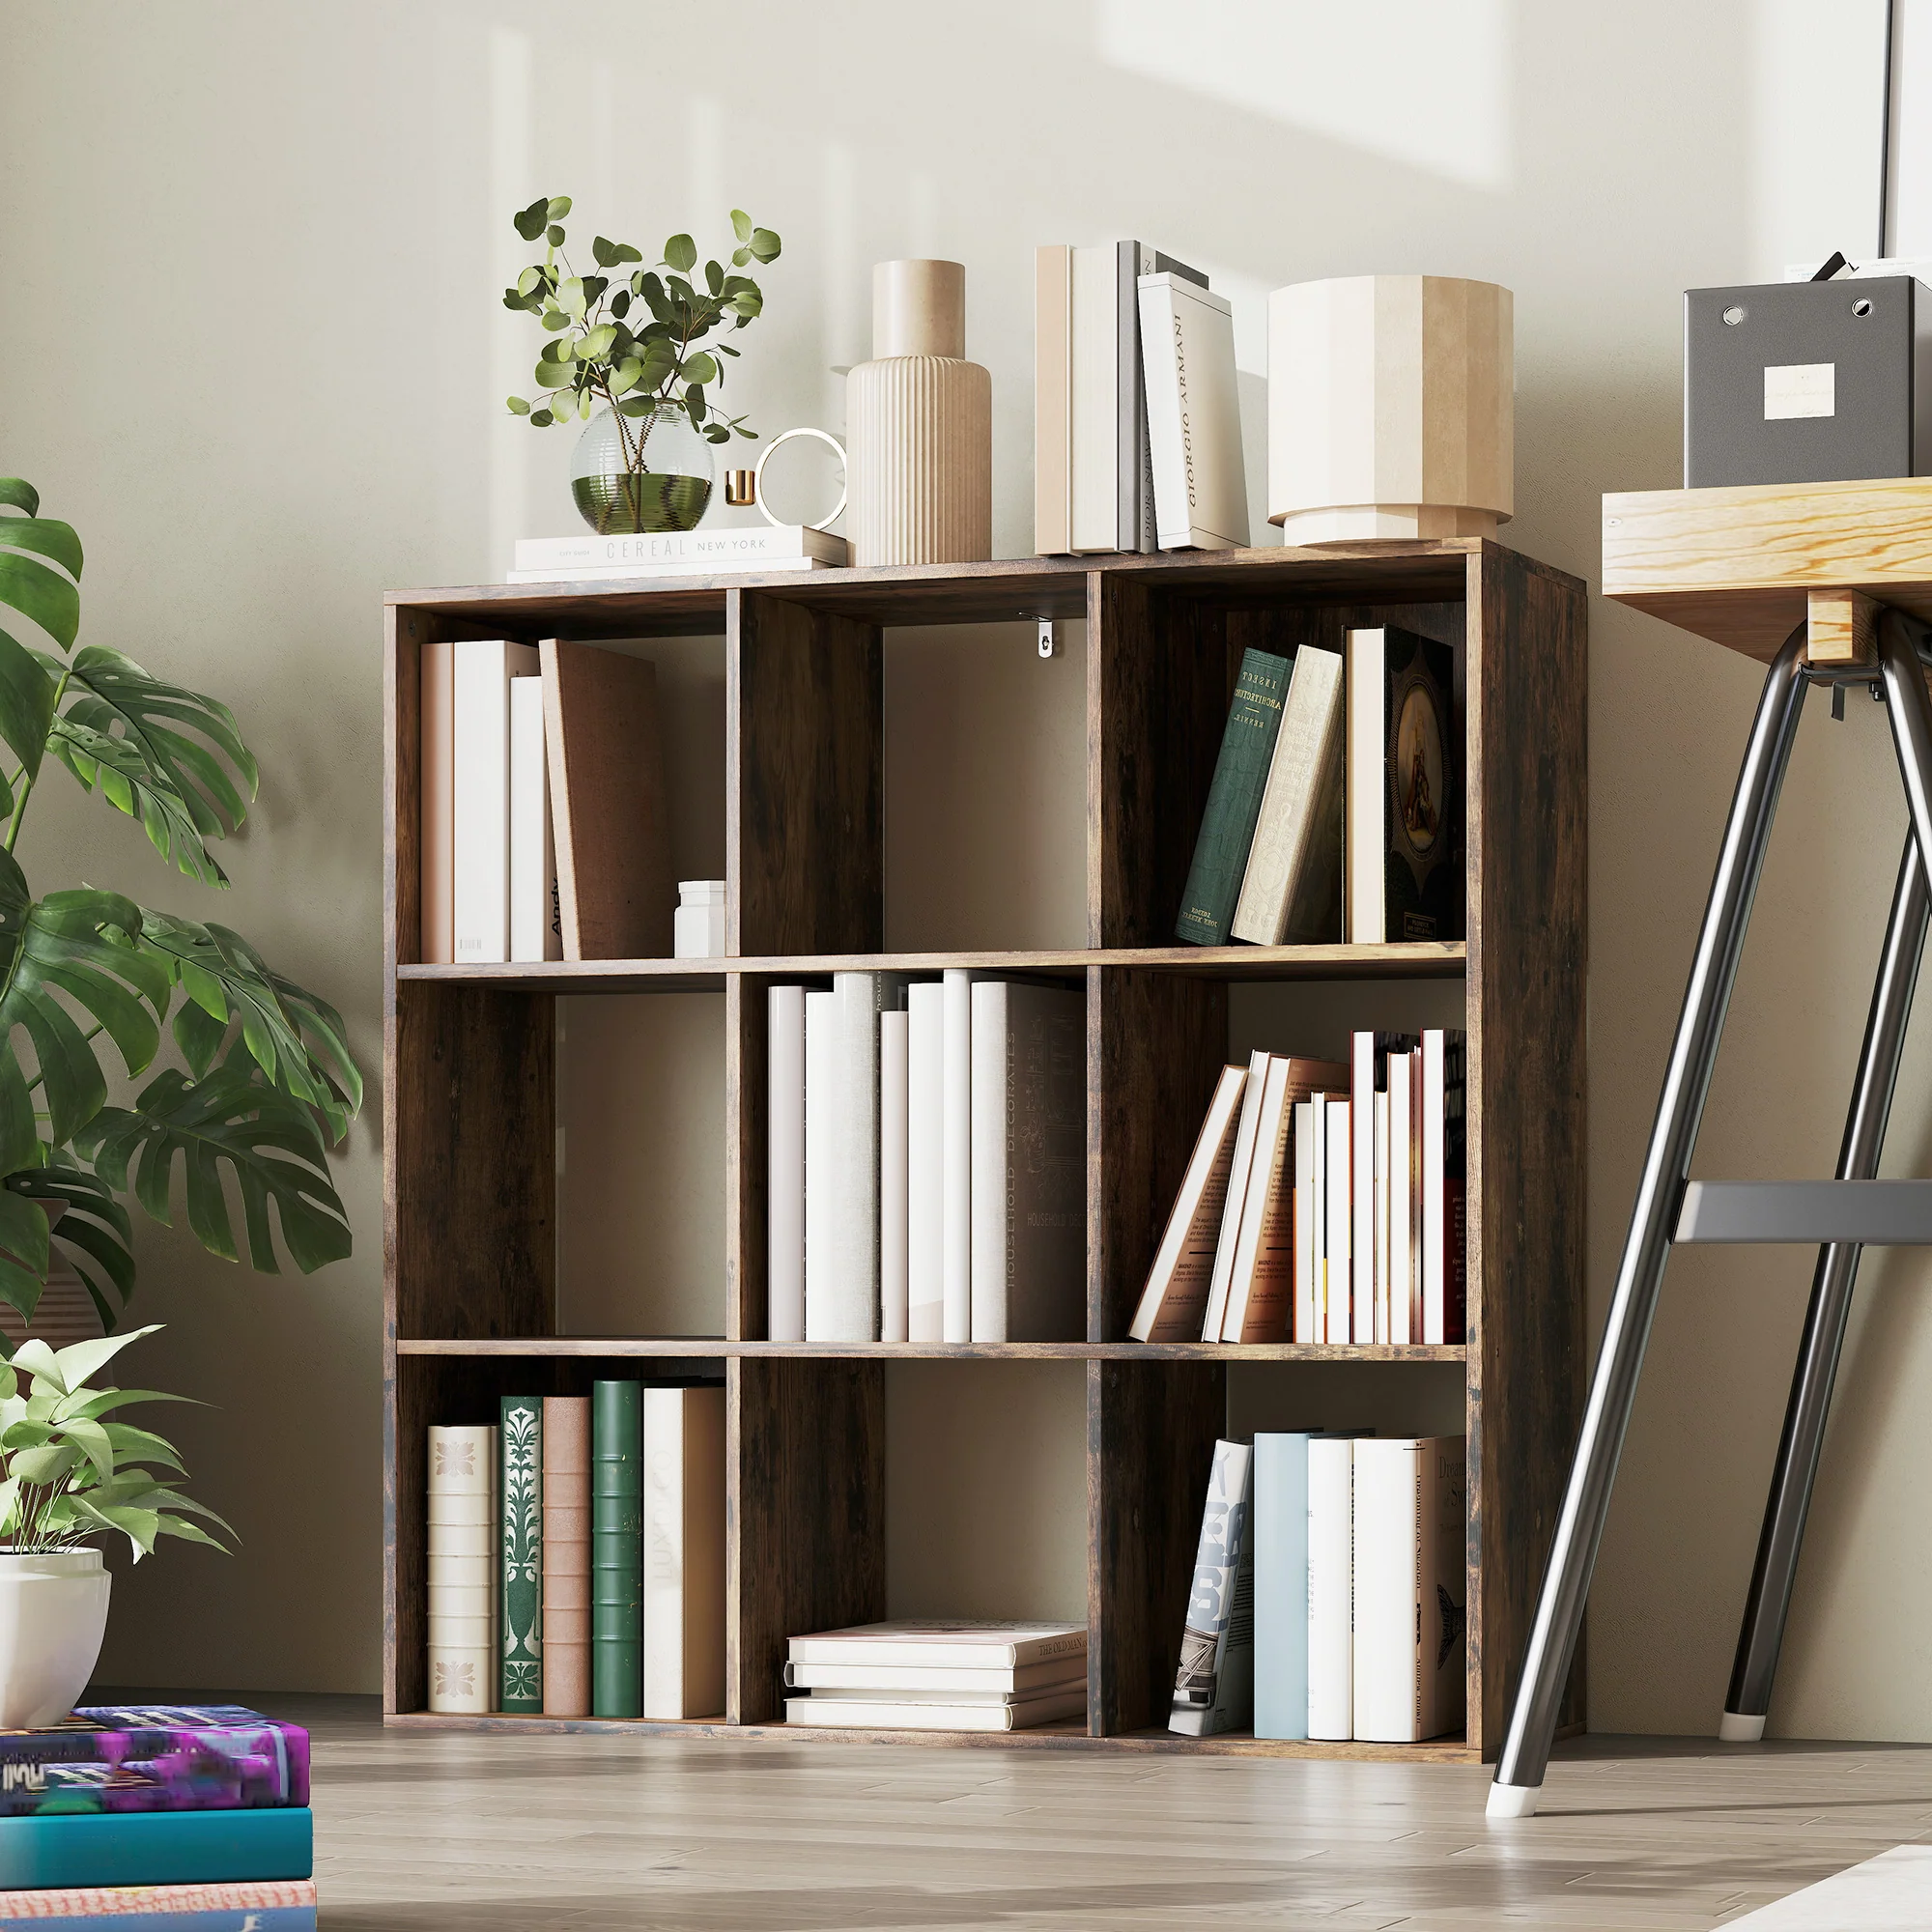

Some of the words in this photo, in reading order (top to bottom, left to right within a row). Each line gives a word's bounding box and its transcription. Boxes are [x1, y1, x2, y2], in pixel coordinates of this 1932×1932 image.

[1174, 313, 1188, 404] ARMANI
[1182, 412, 1196, 508] GIORGIO
[607, 539, 686, 559] CEREAL
[697, 541, 725, 551] NEW
[731, 539, 765, 550] YORK
[1007, 1032, 1015, 1152] DECORATES
[1007, 1166, 1015, 1288] HOUSEHOLD
[1027, 1212, 1065, 1227] HOUSEHOLD
[1038, 1643, 1053, 1656] THE
[1053, 1640, 1067, 1653] OLD
